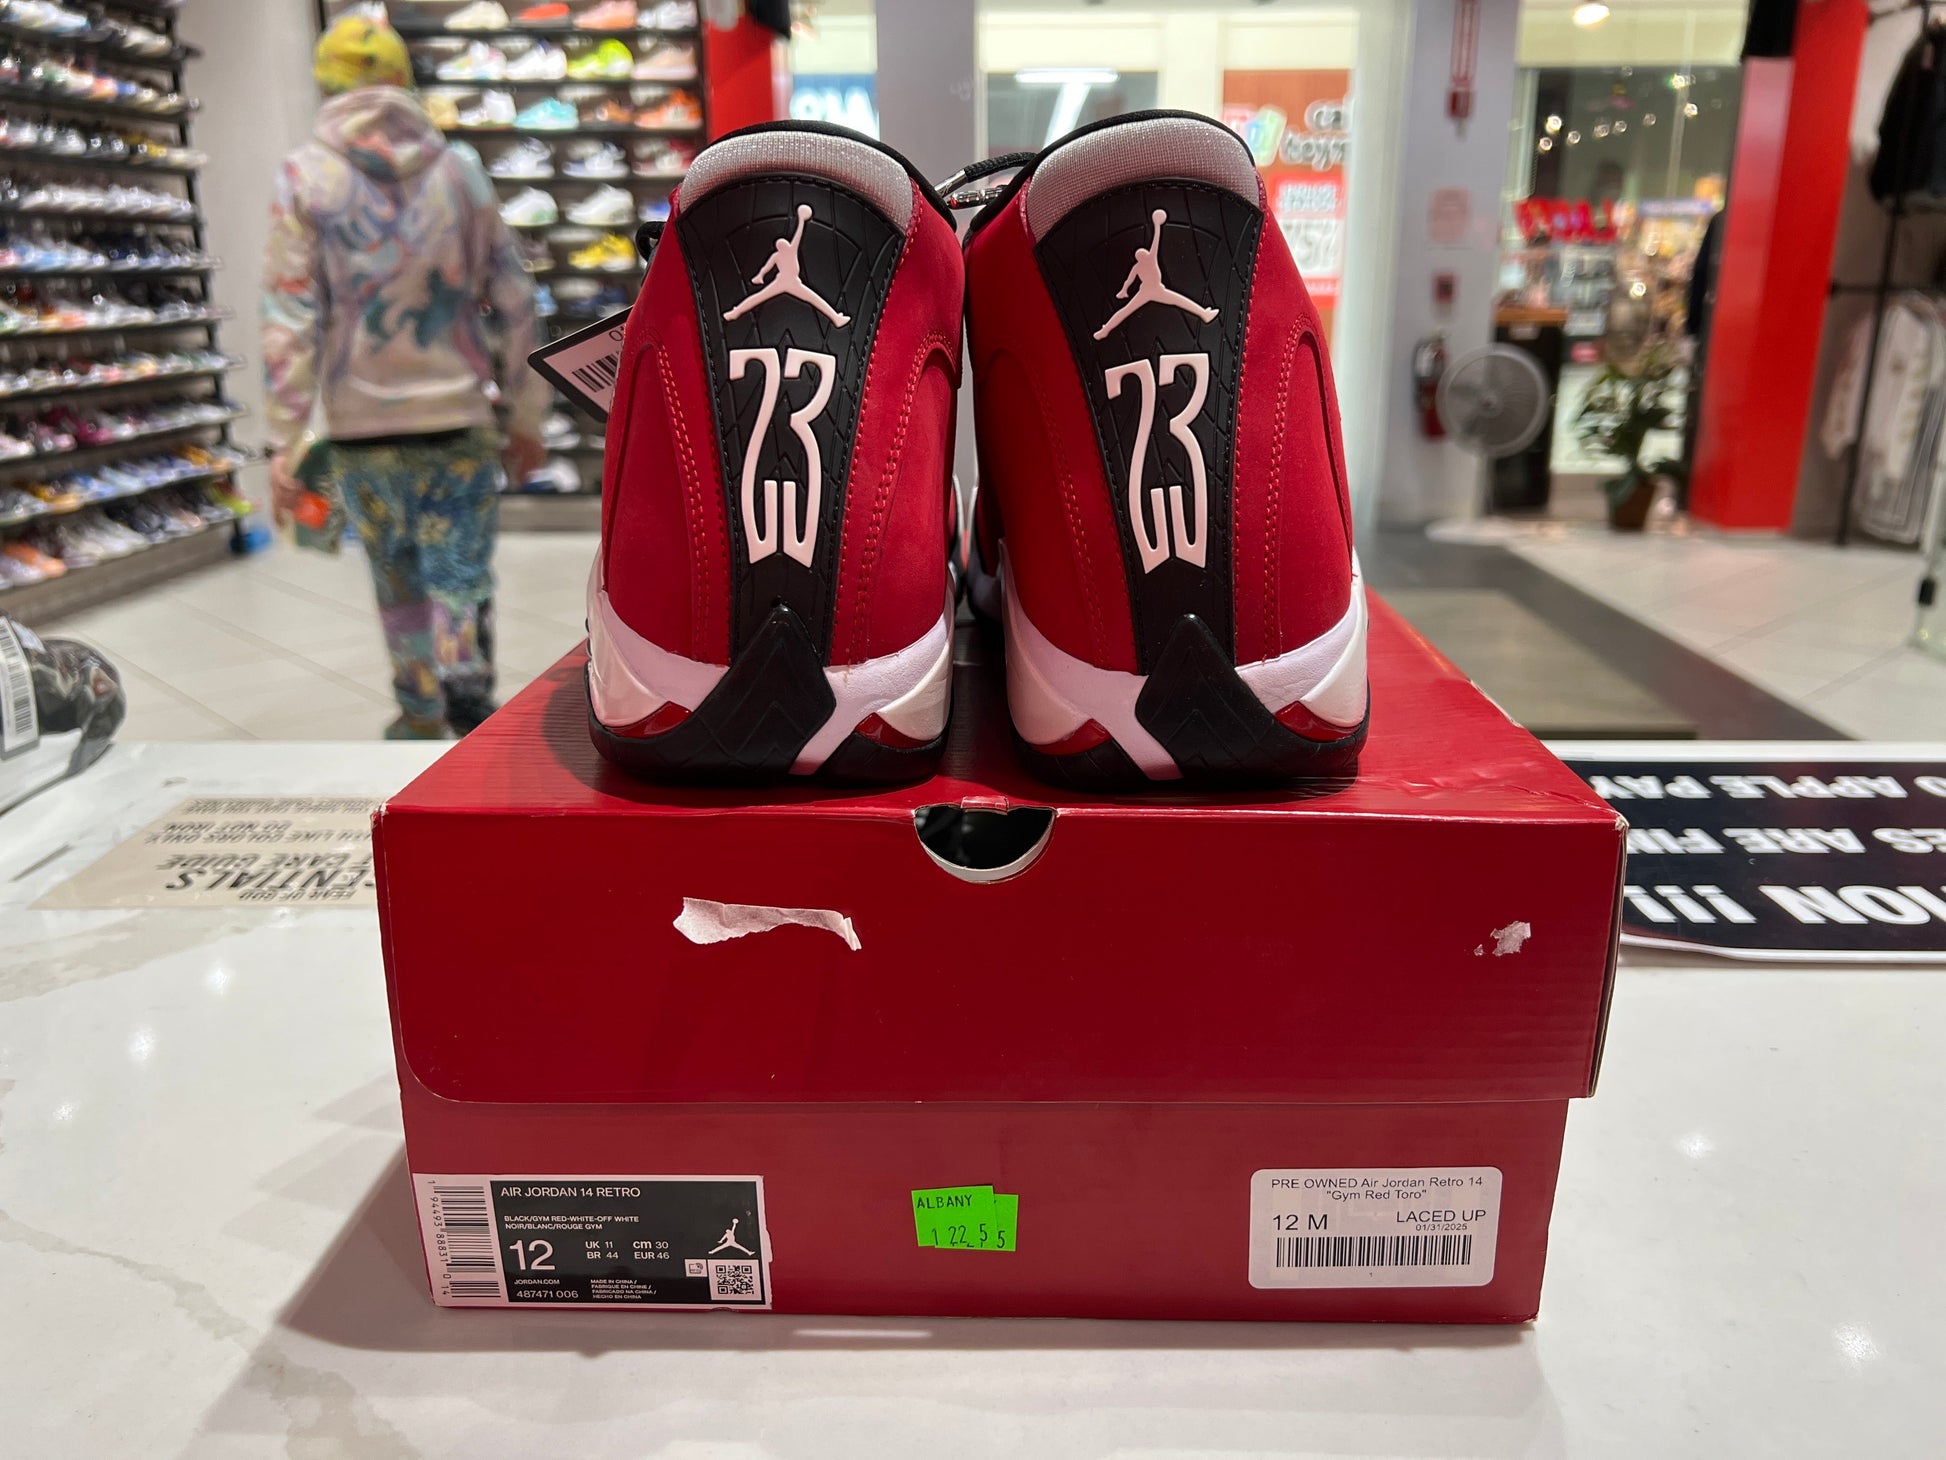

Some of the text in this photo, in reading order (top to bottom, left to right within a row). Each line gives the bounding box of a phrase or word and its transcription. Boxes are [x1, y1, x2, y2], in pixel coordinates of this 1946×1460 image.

[729, 347, 837, 569] 23
[1104, 352, 1210, 574] 23
[1589, 775, 1713, 799] PAY
[1708, 775, 1909, 799] APPLE
[1627, 827, 1726, 854] FIN
[1722, 827, 1867, 854] ARE
[165, 869, 374, 891] ENTIALS
[1271, 1176, 1483, 1188] PRE OWNED Air Jordan Retro 14
[501, 1187, 641, 1197] AIR JORDAN 14 RETRO
[1326, 1190, 1427, 1202] "Gym Red Toro"
[917, 1194, 973, 1209] ALBANY
[1272, 1214, 1328, 1231] 12 M
[1396, 1209, 1486, 1223] LACED UP
[1415, 1224, 1468, 1232] 01/31/2025
[585, 1241, 614, 1249] UK 11
[632, 1240, 669, 1250] cm 30
[509, 1239, 556, 1271] 12
[586, 1251, 602, 1259] BR
[634, 1252, 670, 1260] EUR 46
[516, 1290, 579, 1298] 487471 006
